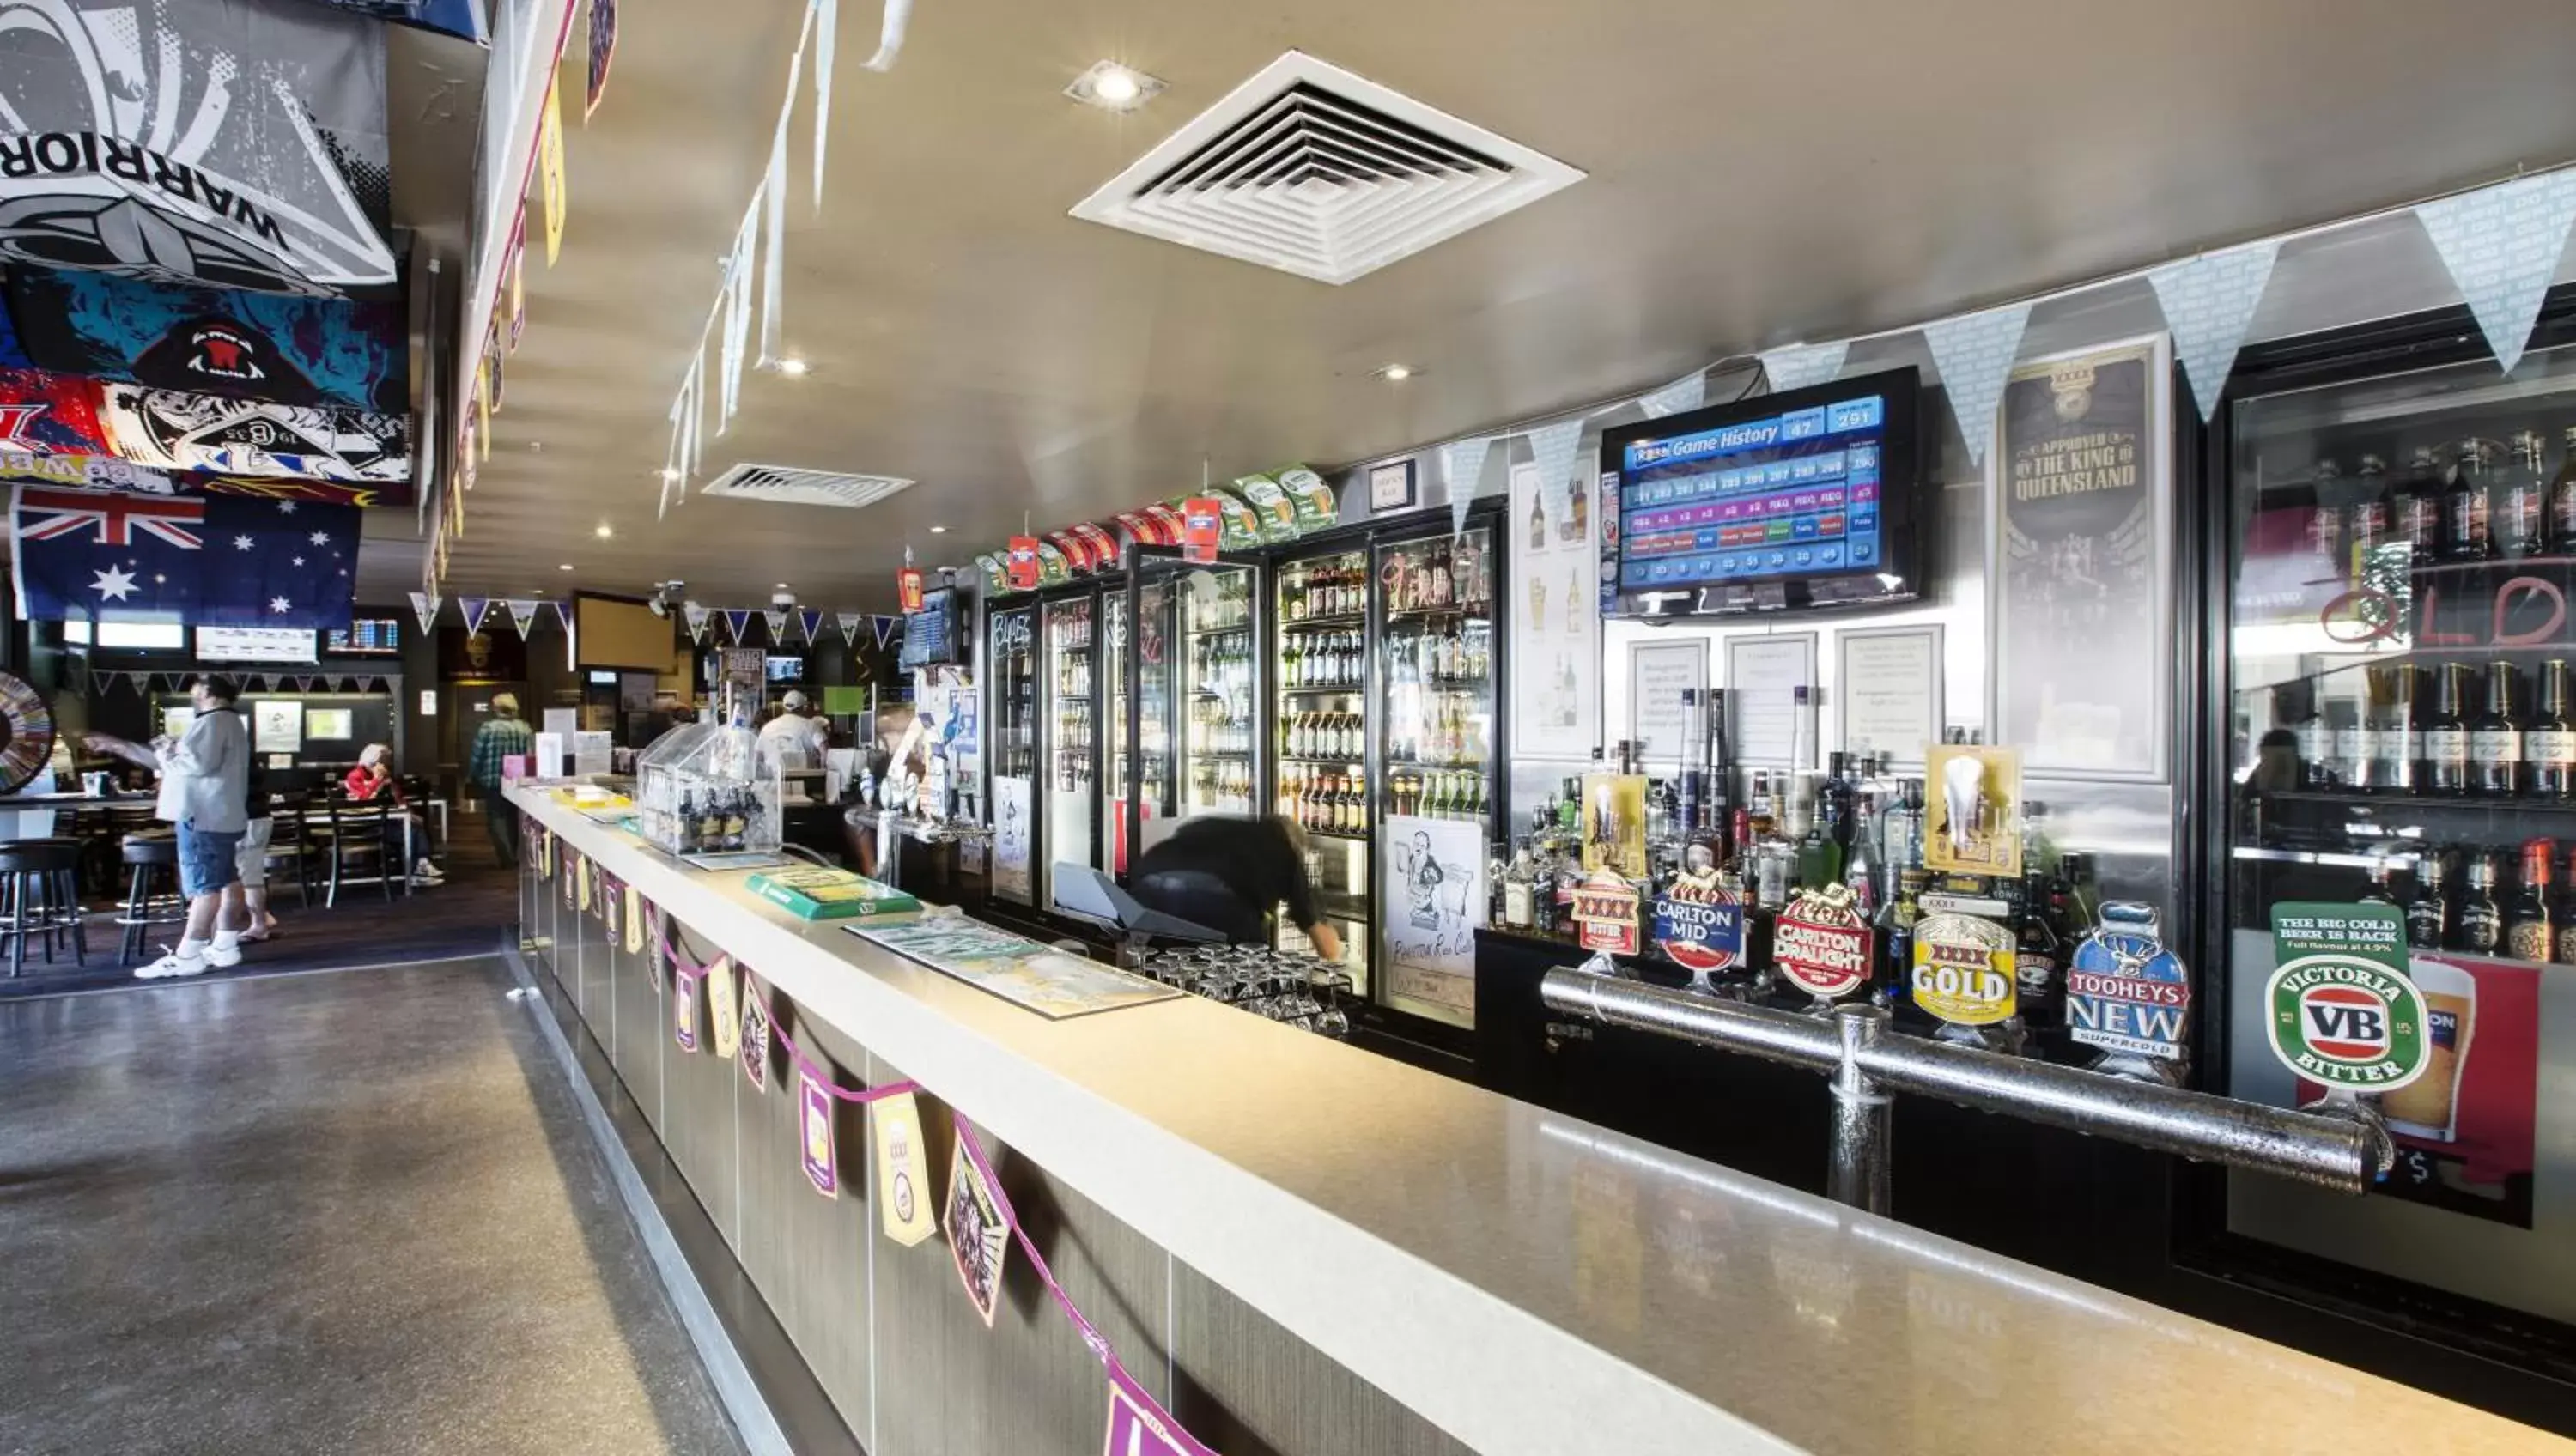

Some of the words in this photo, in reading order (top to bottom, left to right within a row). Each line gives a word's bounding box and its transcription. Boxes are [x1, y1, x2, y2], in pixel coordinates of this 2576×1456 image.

[1674, 438, 1718, 457] Game
[1721, 425, 1778, 449] History
[2041, 433, 2106, 454] APPROVED
[2034, 455, 2065, 477] THE
[2071, 446, 2116, 471] KING
[2016, 464, 2136, 501] QUEENSLAND
[2321, 576, 2566, 646] QLD
[1656, 901, 1732, 927] CARLTON
[2279, 918, 2314, 928] THE
[2317, 918, 2347, 929] BIG
[2348, 919, 2397, 930] COLD
[1671, 920, 1708, 940] MID
[1777, 924, 1862, 954] CARLTON
[2280, 928, 2323, 939] BEER
[2327, 930, 2345, 939] IS
[2348, 930, 2397, 942] BACK
[2287, 940, 2307, 949] Full
[1773, 938, 1866, 971] DRAUGHT
[1932, 943, 1988, 965] XXXX
[1912, 964, 2009, 1003] GOLD
[2075, 974, 2179, 1004] TOOHEYS
[2281, 966, 2403, 1004] VICTORIA
[2066, 994, 2184, 1042] NEW
[2306, 1005, 2385, 1041] VB
[2080, 1032, 2171, 1054] SUPERCOLD
[2295, 1052, 2405, 1082] BITTER
